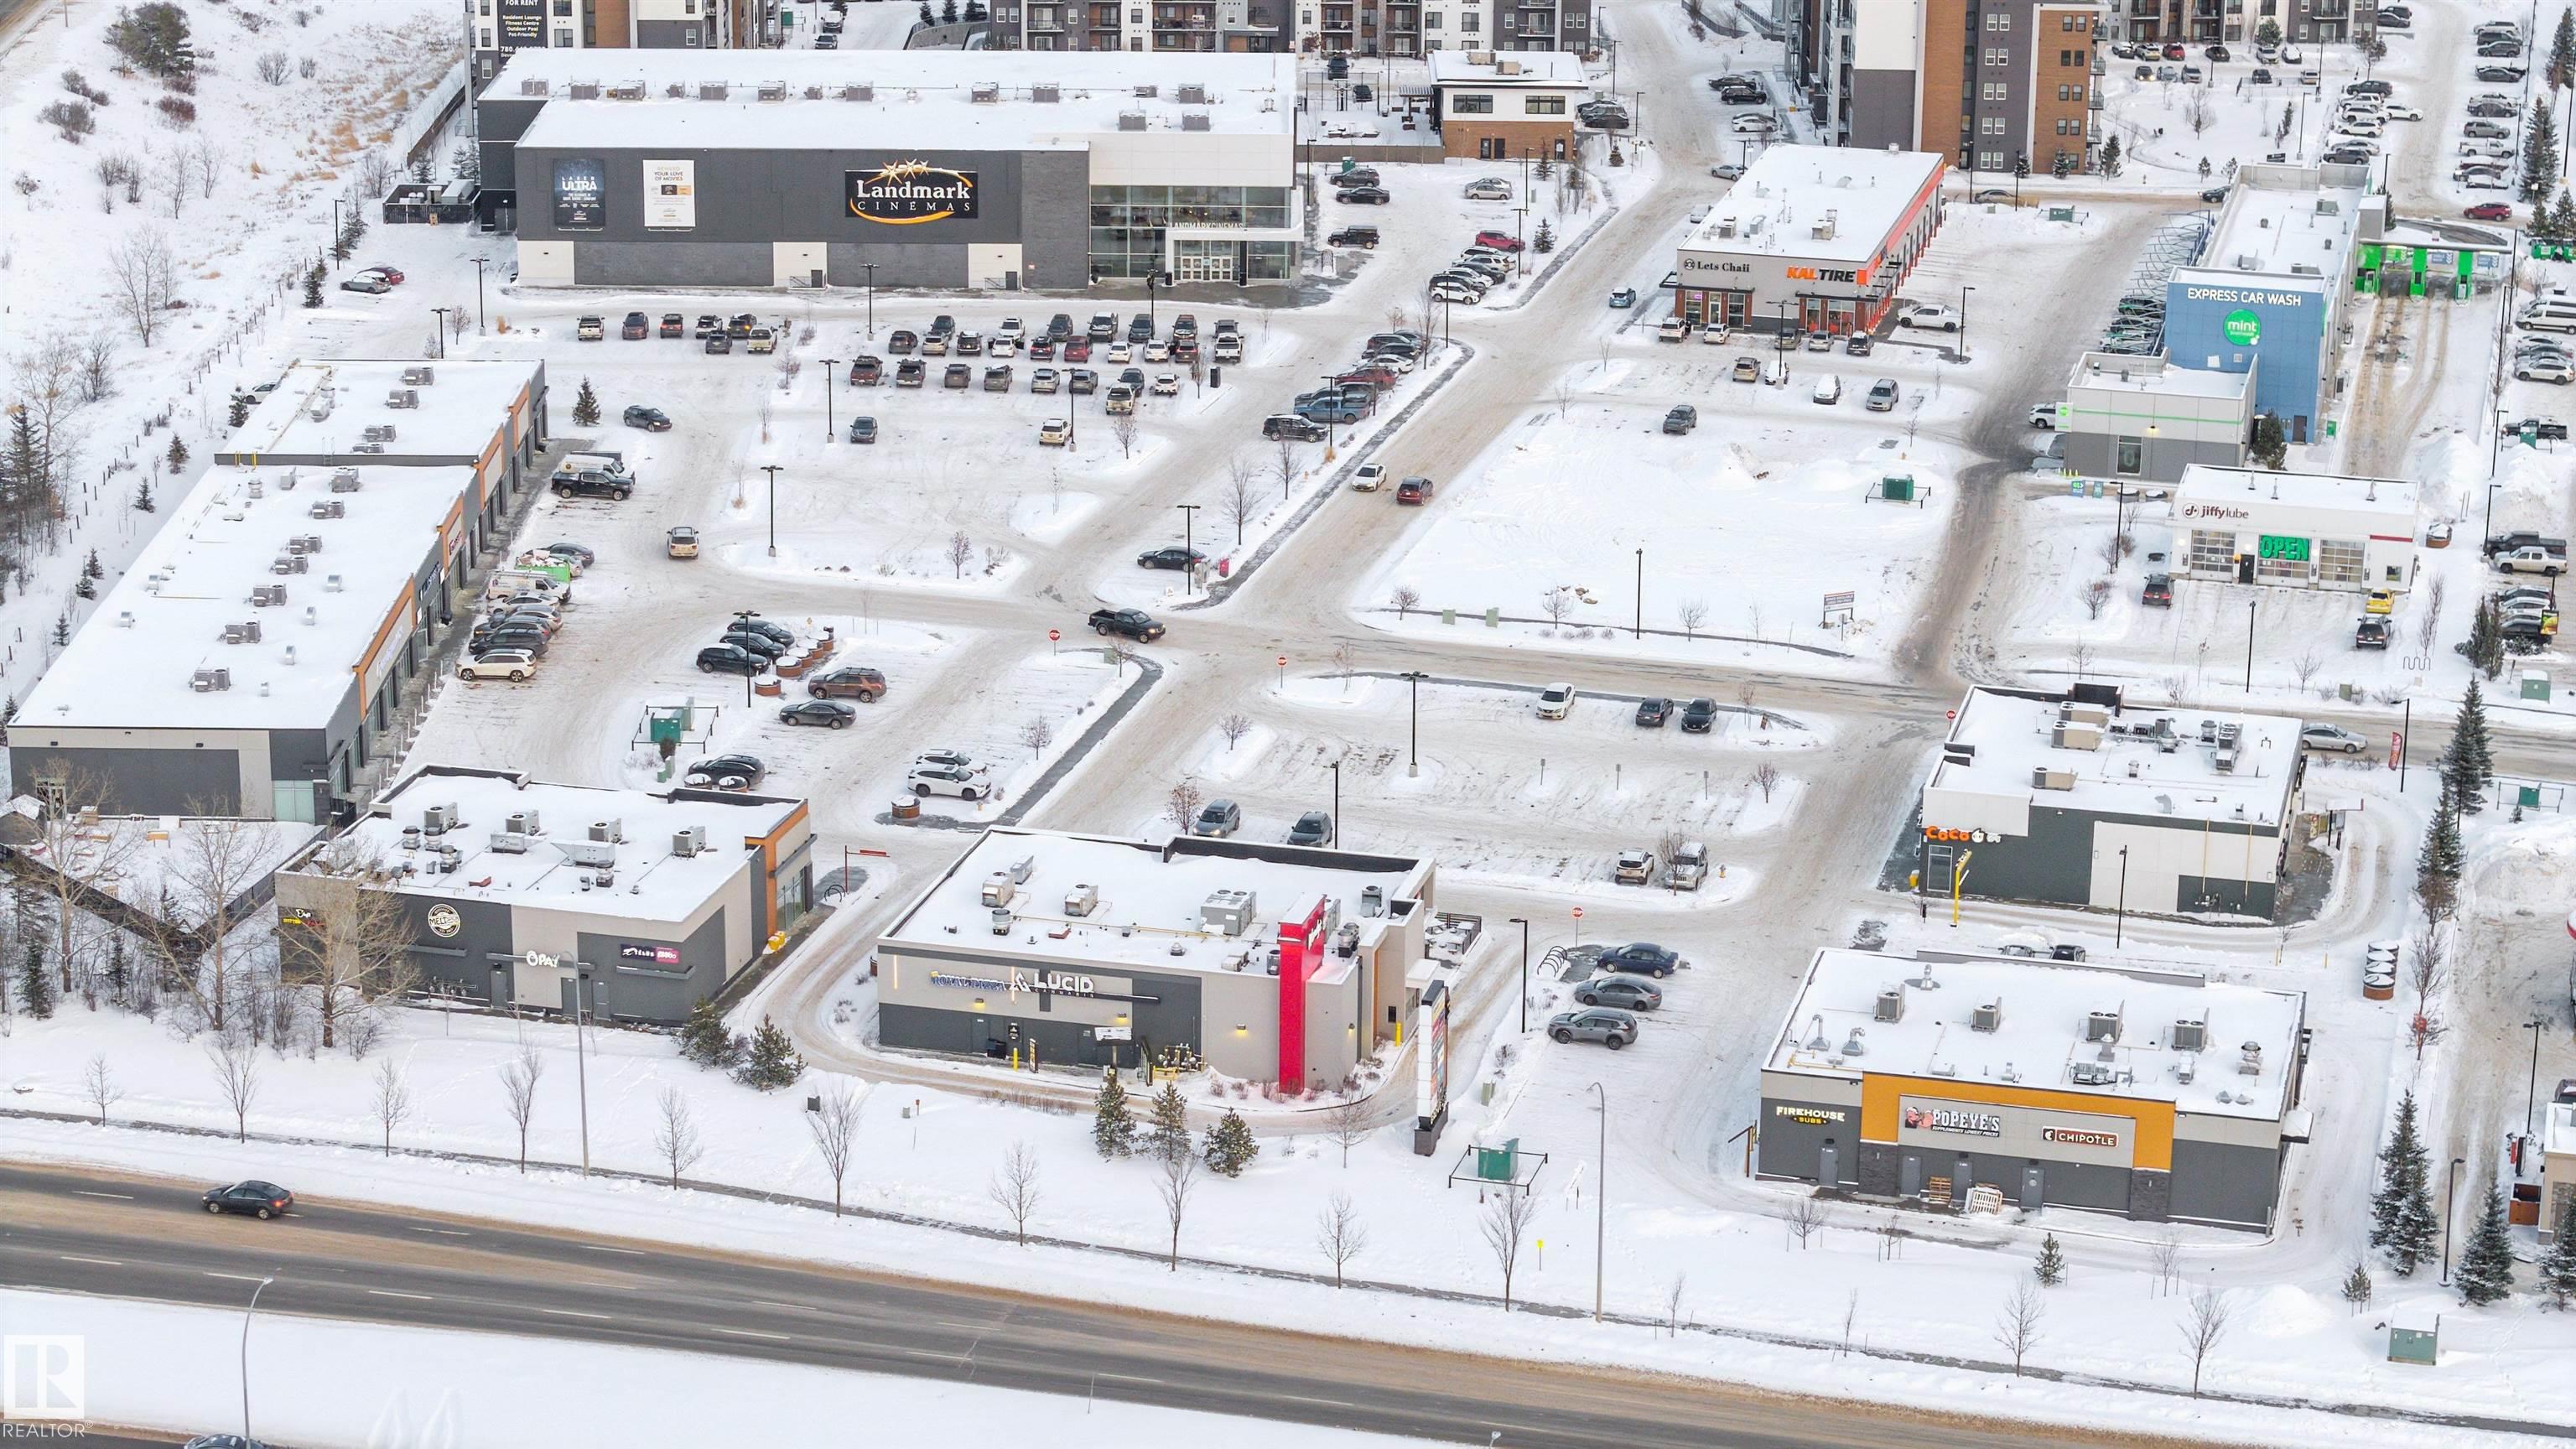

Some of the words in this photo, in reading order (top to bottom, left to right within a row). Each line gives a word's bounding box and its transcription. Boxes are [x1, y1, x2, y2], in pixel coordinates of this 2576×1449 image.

[562, 180, 597, 191] ULTRA
[856, 179, 970, 199] Landmark
[857, 201, 970, 210] CINEMAS
[1697, 261, 1719, 271] Lets
[1722, 262, 1750, 273] Chaii
[1787, 266, 1818, 281] KAL
[1819, 268, 1856, 283] TIRE
[2187, 287, 2238, 302] EXPRESS
[2241, 291, 2264, 304] CAR
[2267, 293, 2301, 307] WASH
[2227, 319, 2257, 332] mint
[2200, 506, 2225, 519] jiffy
[2226, 506, 2249, 519] lube
[2259, 534, 2310, 561] OPEN
[1034, 973, 1094, 993] LUCID
[1776, 1106, 1845, 1122] FIREHOUSE
[1932, 1109, 2000, 1131] POPEYE'S
[2059, 1132, 2115, 1145] CHIPOTLE
